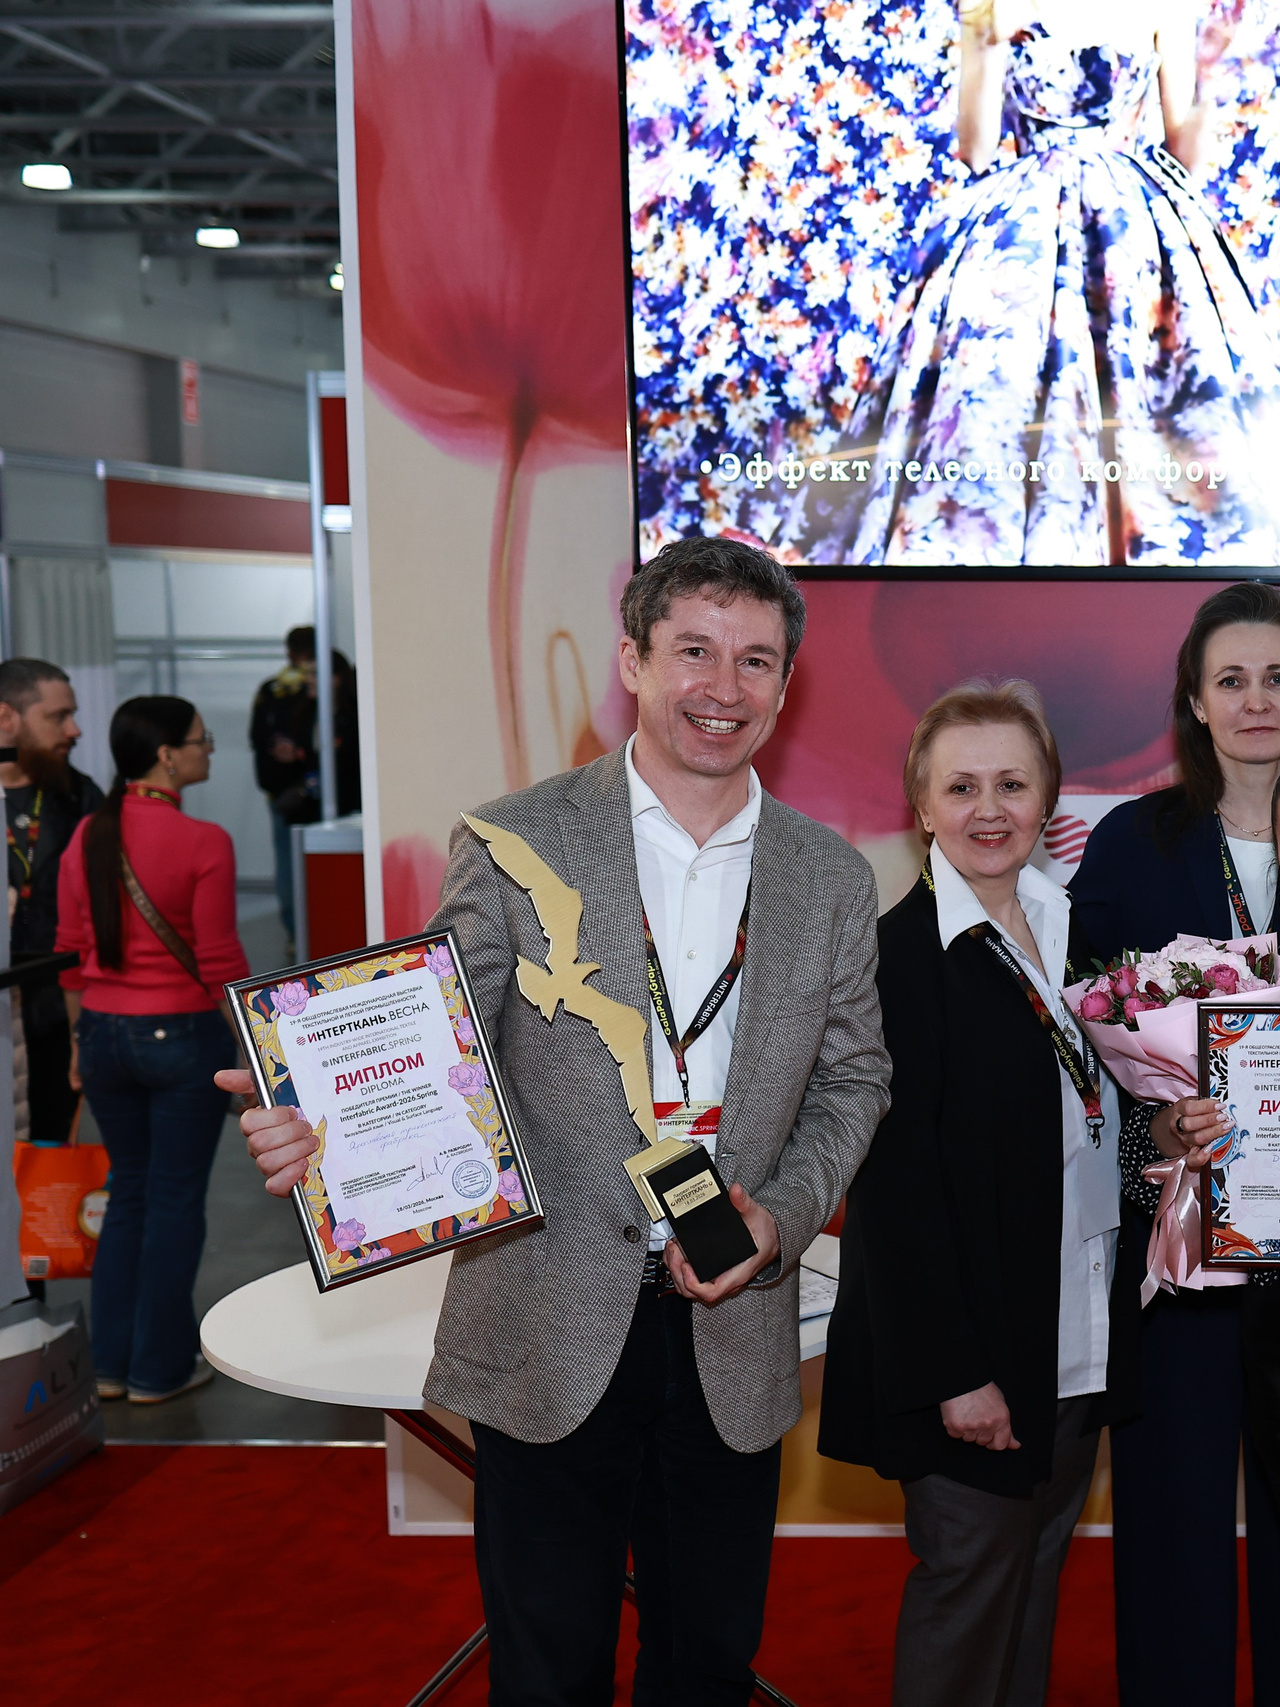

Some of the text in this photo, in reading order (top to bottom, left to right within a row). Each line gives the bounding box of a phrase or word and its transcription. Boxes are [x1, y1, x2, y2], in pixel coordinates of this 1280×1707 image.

[885, 456, 1065, 483] телесного
[1080, 452, 1227, 490] комфор
[984, 936, 1022, 977] ИНТЕРТКАНЬ
[306, 1001, 430, 1043] ИНТЕРТКАНЬ.ВЕСНА
[694, 980, 729, 1030] INTERFABRIC
[328, 1033, 422, 1066] INTERFABRIC.SPRING
[1050, 1030, 1084, 1089] GalaPolyGraph
[334, 1052, 425, 1094] ДИПЛОМ
[359, 1076, 404, 1095] DIPLOMA
[339, 1088, 438, 1122] Interfabric Award-2026.Spring
[361, 1114, 391, 1126] КАТЕГОРИИ
[401, 1103, 427, 1114] CATEGORY
[674, 1183, 709, 1205] ИНТЕРТКАНЬ
